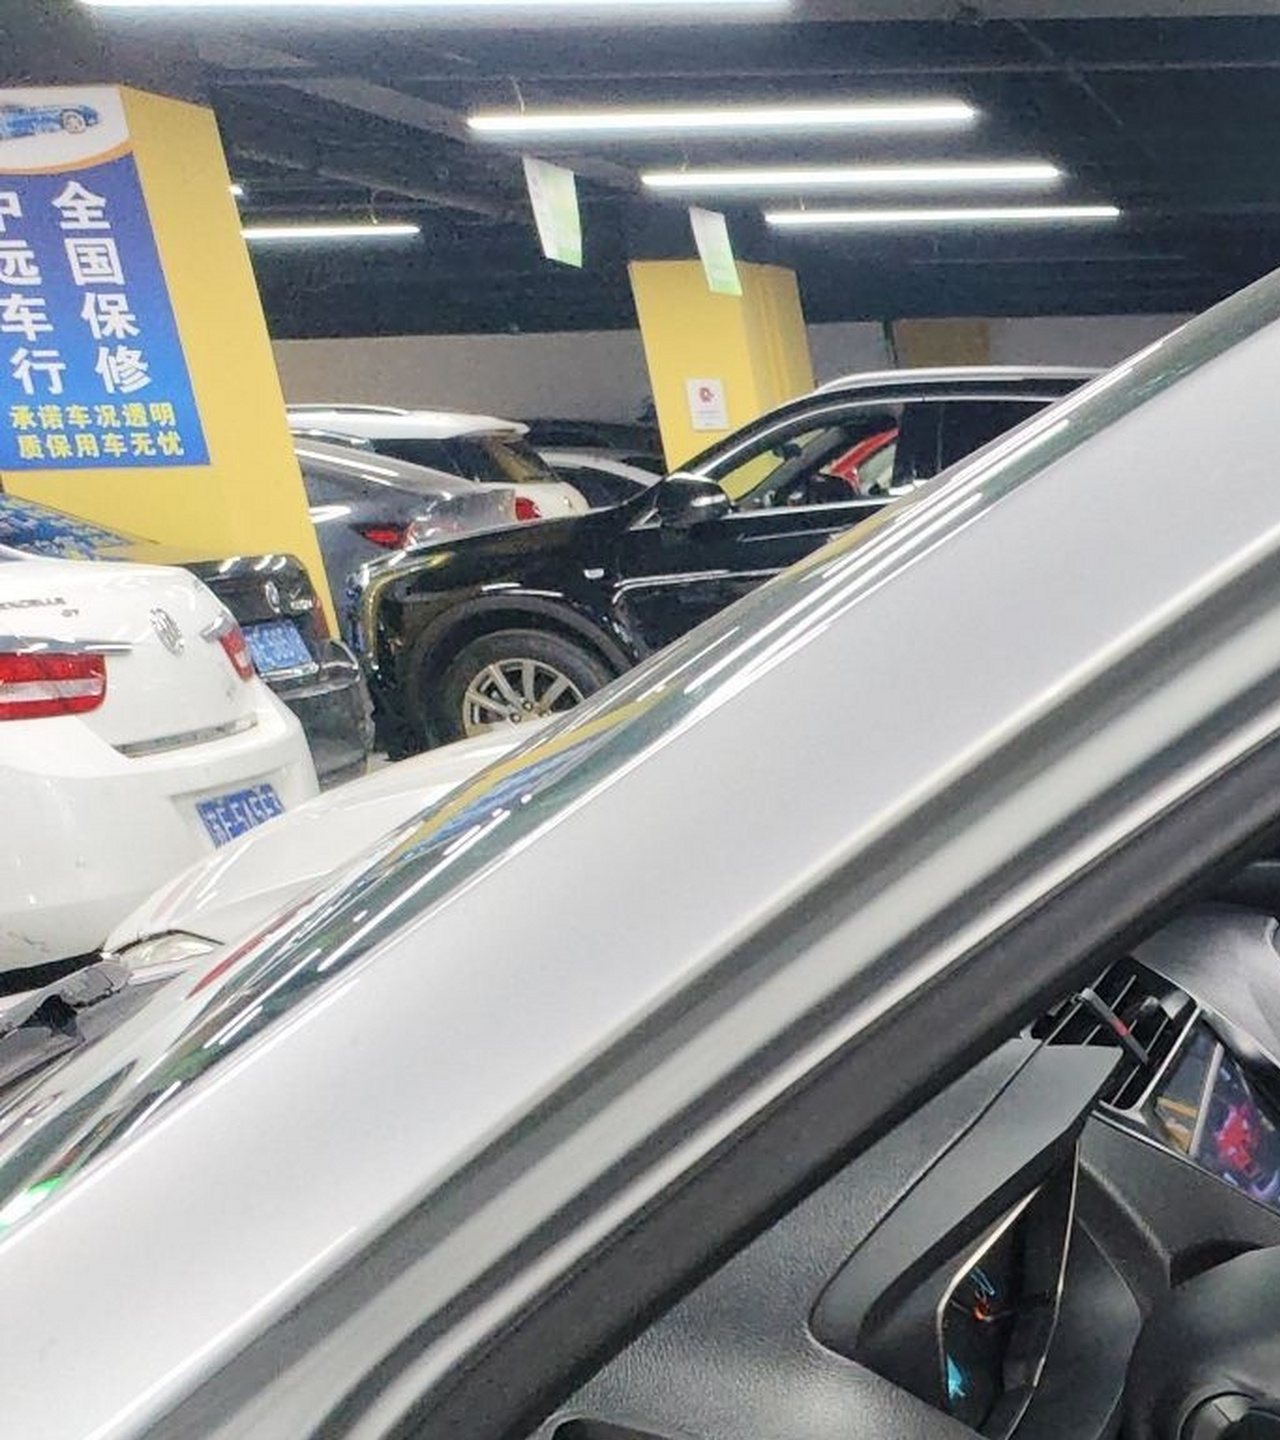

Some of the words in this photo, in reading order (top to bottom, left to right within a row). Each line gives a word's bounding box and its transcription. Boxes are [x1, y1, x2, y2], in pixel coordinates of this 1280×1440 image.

[52, 180, 152, 394] 全国保修
[9, 402, 177, 430] 承诺车况透明
[18, 430, 185, 459] 质保用车无忧
